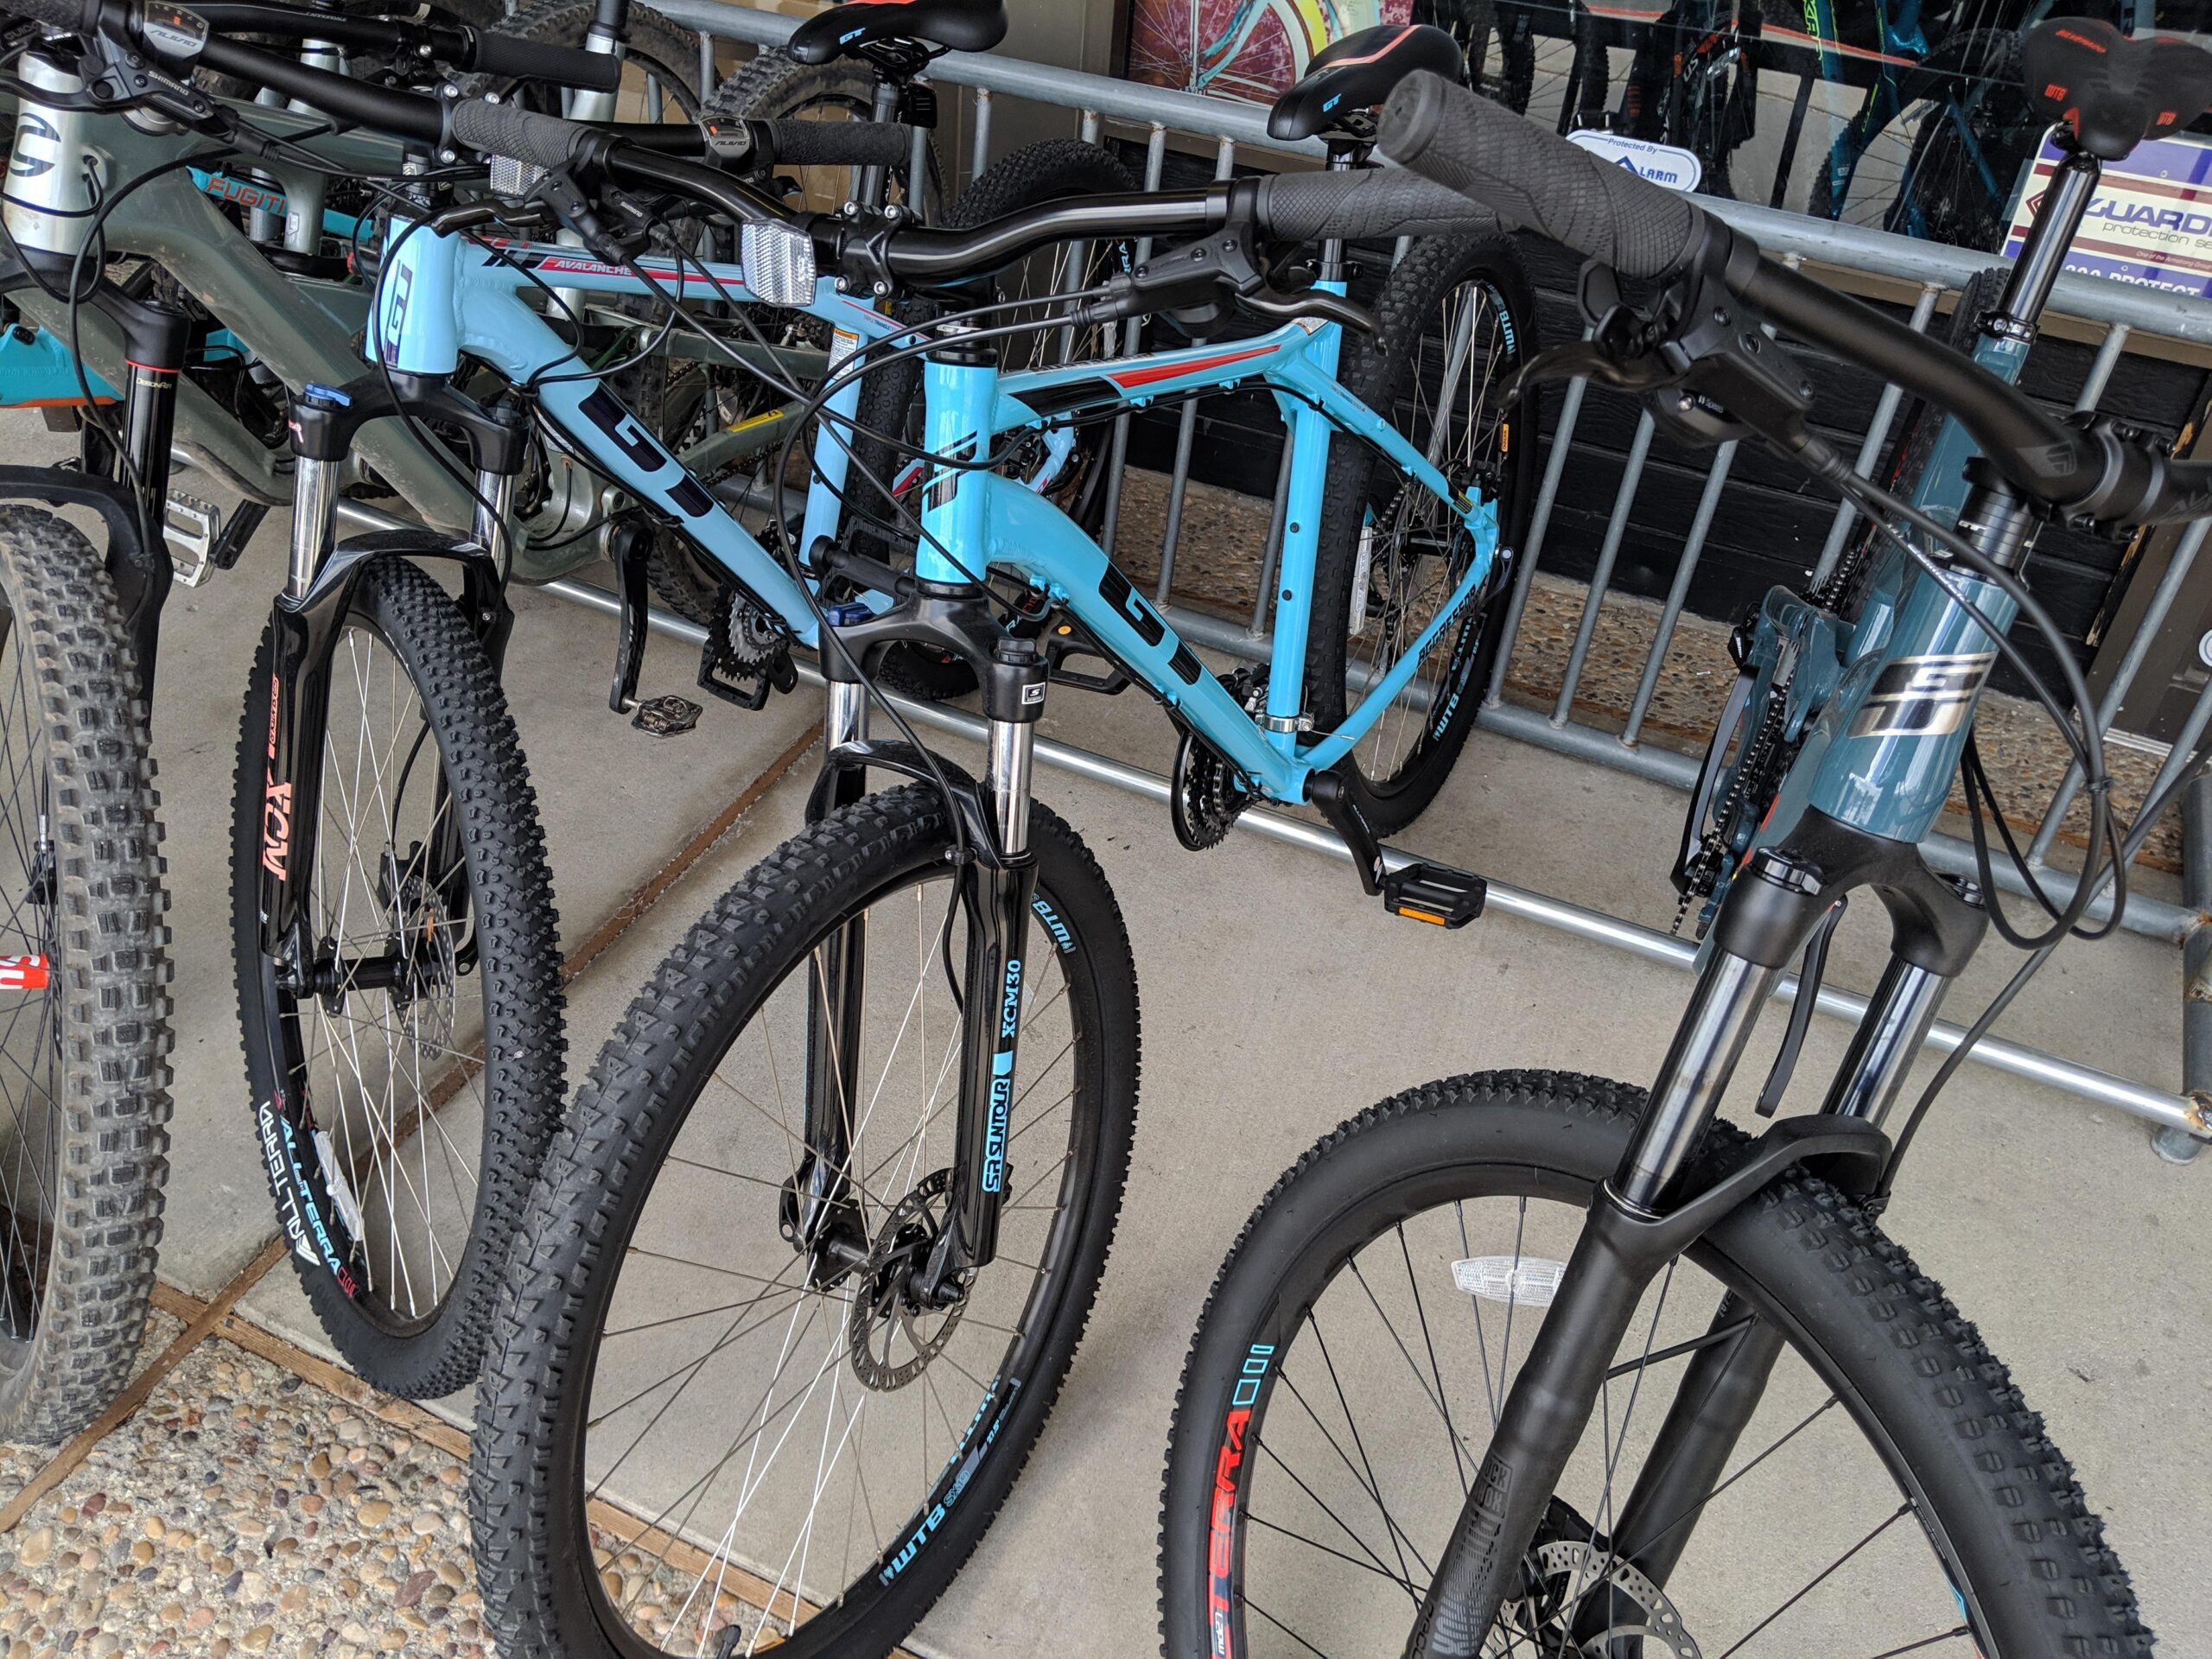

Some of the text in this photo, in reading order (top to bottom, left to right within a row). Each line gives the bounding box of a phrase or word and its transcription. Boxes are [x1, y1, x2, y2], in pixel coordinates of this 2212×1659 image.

[150, 29, 198, 48] ALIVIO
[839, 27, 866, 45] GT
[148, 70, 190, 96] SHIMANO
[1322, 92, 1342, 112] GT
[1607, 137, 1658, 155] Protected By
[207, 177, 285, 214] FUGITI
[2084, 198, 2212, 235] GUARD
[2102, 222, 2190, 245] protection
[556, 260, 632, 276] AVALANCHE
[1438, 693, 1459, 734] WTB
[1032, 900, 1071, 943] WTB
[1001, 959, 1021, 1038] XCM30
[989, 1081, 1009, 1159] SUNTOUR
[891, 1503, 946, 1573] WTB
